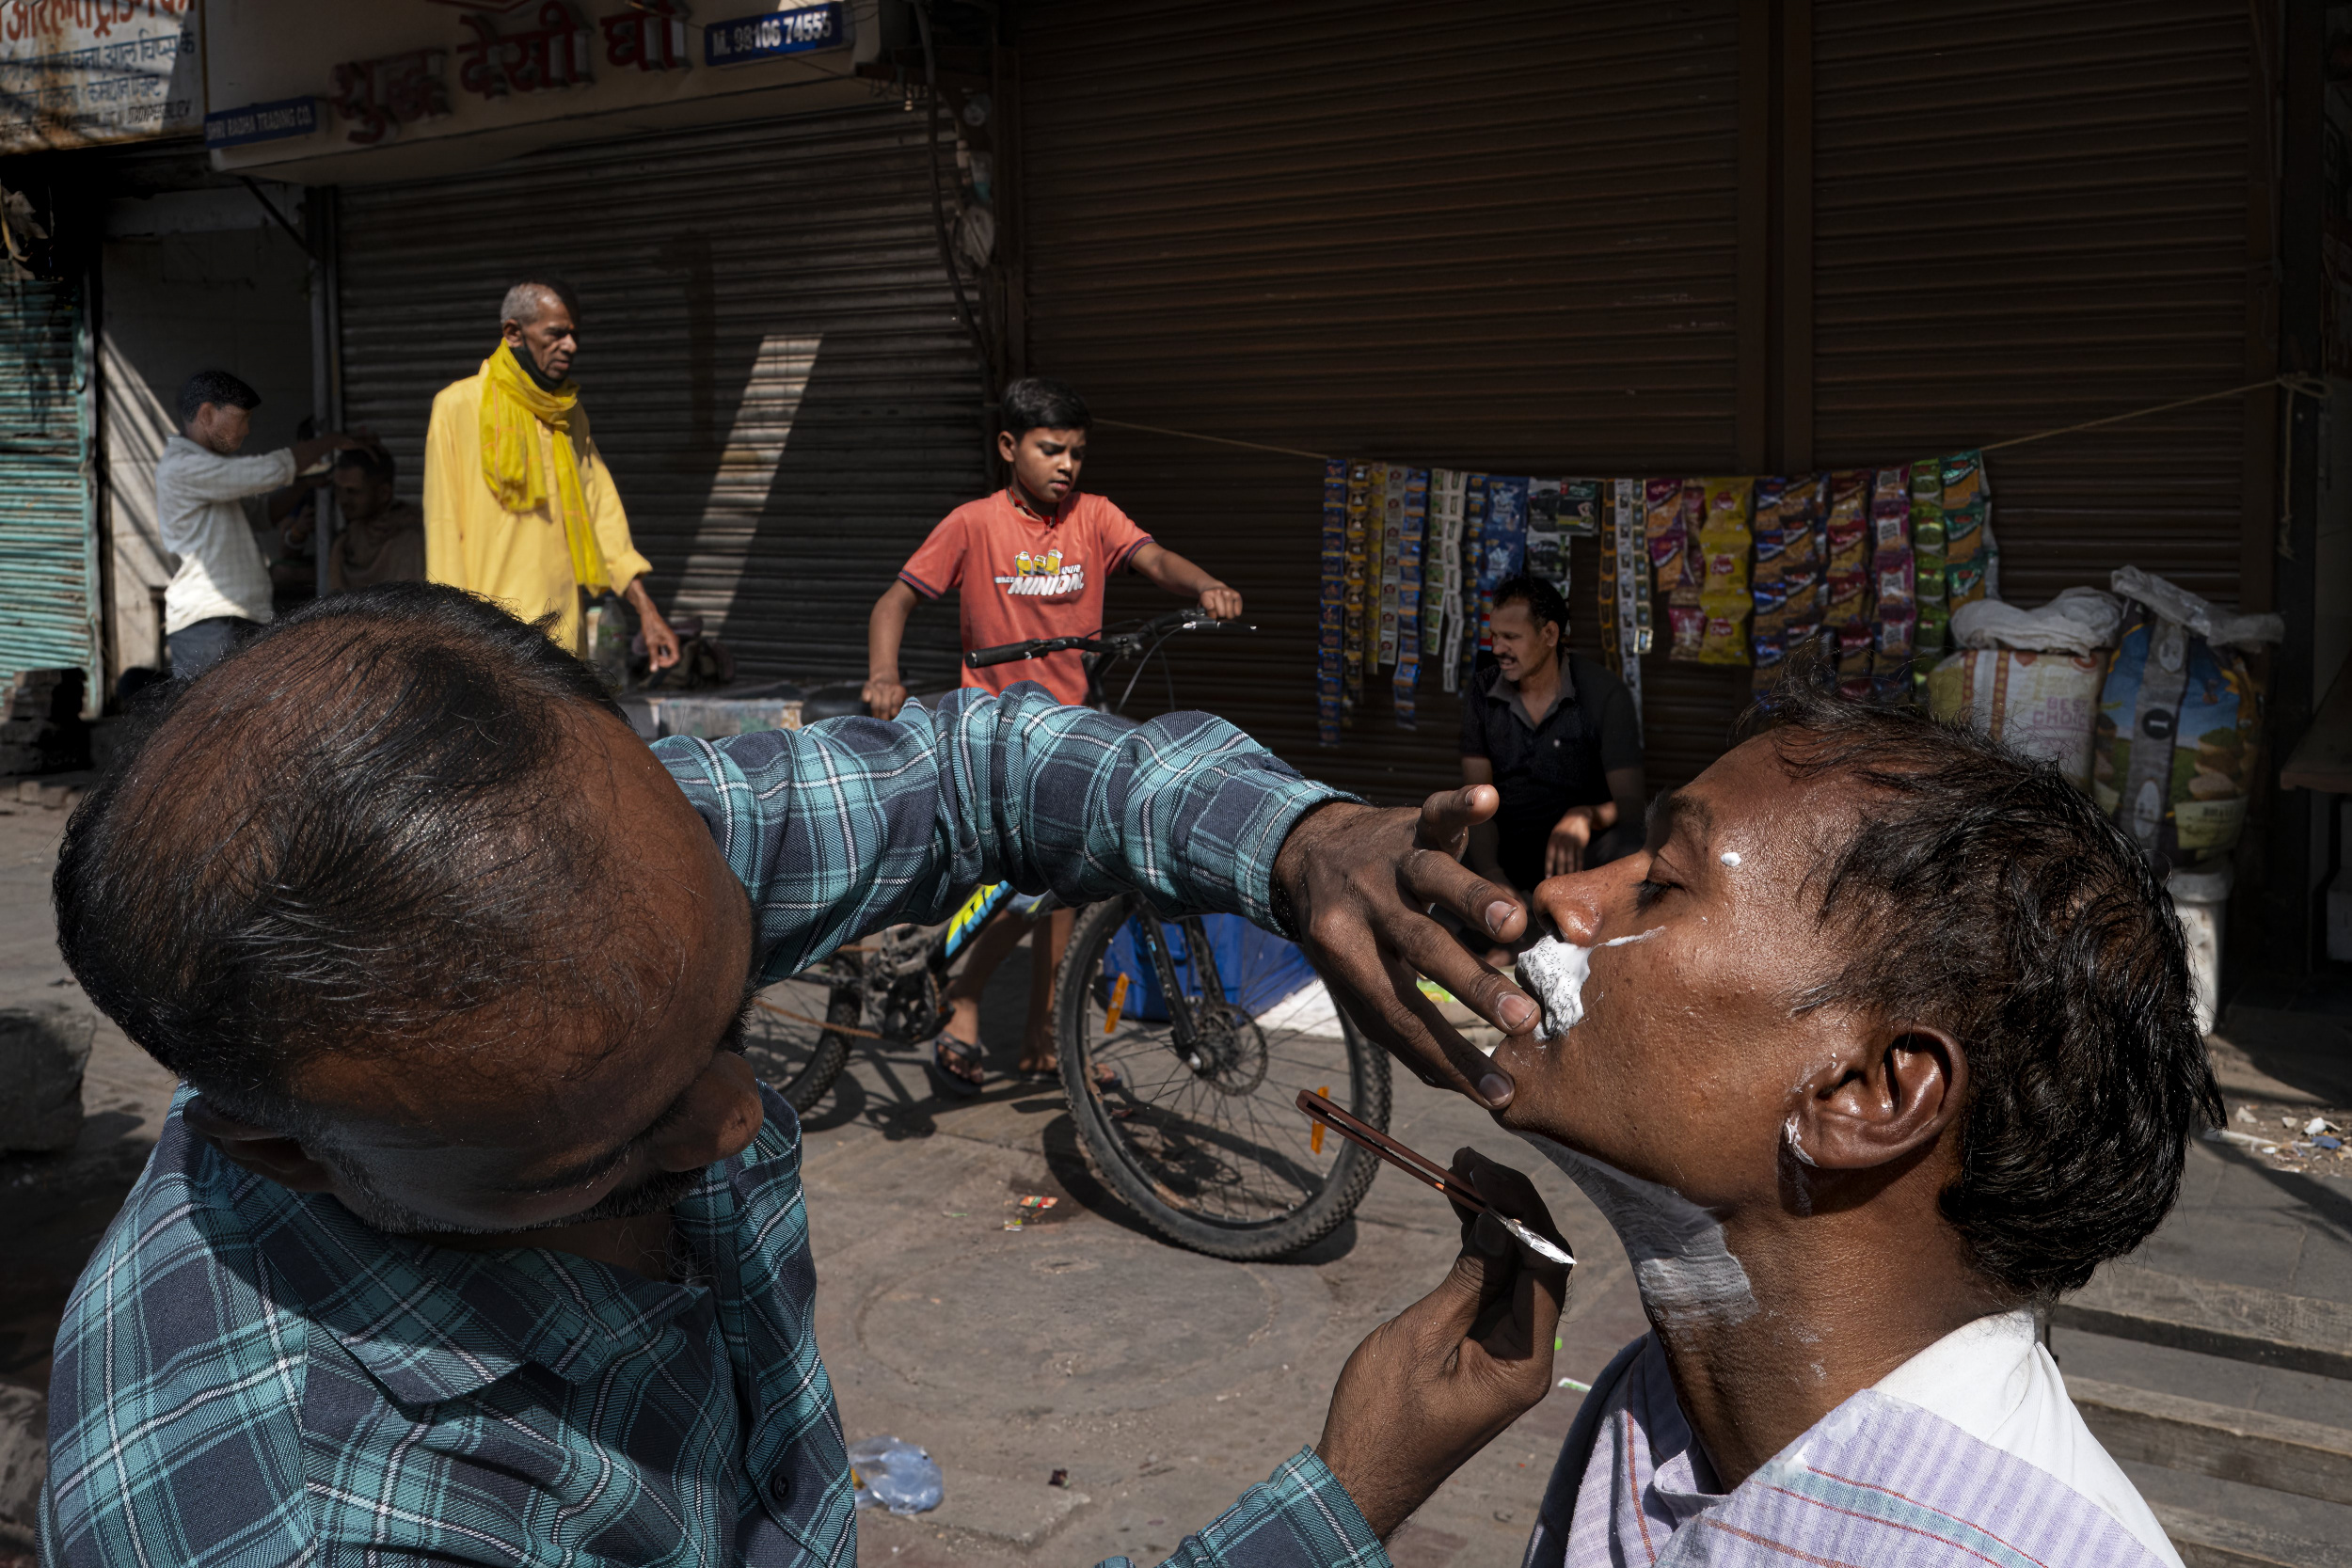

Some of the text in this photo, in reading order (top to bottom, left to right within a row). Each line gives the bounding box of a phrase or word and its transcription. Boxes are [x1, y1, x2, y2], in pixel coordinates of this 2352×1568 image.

[733, 19, 782, 53] 98106
[783, 10, 833, 45] 74555
[329, 47, 450, 144] शुद्ध
[456, 0, 585, 100] देसी
[2046, 697, 2088, 713] BEST
